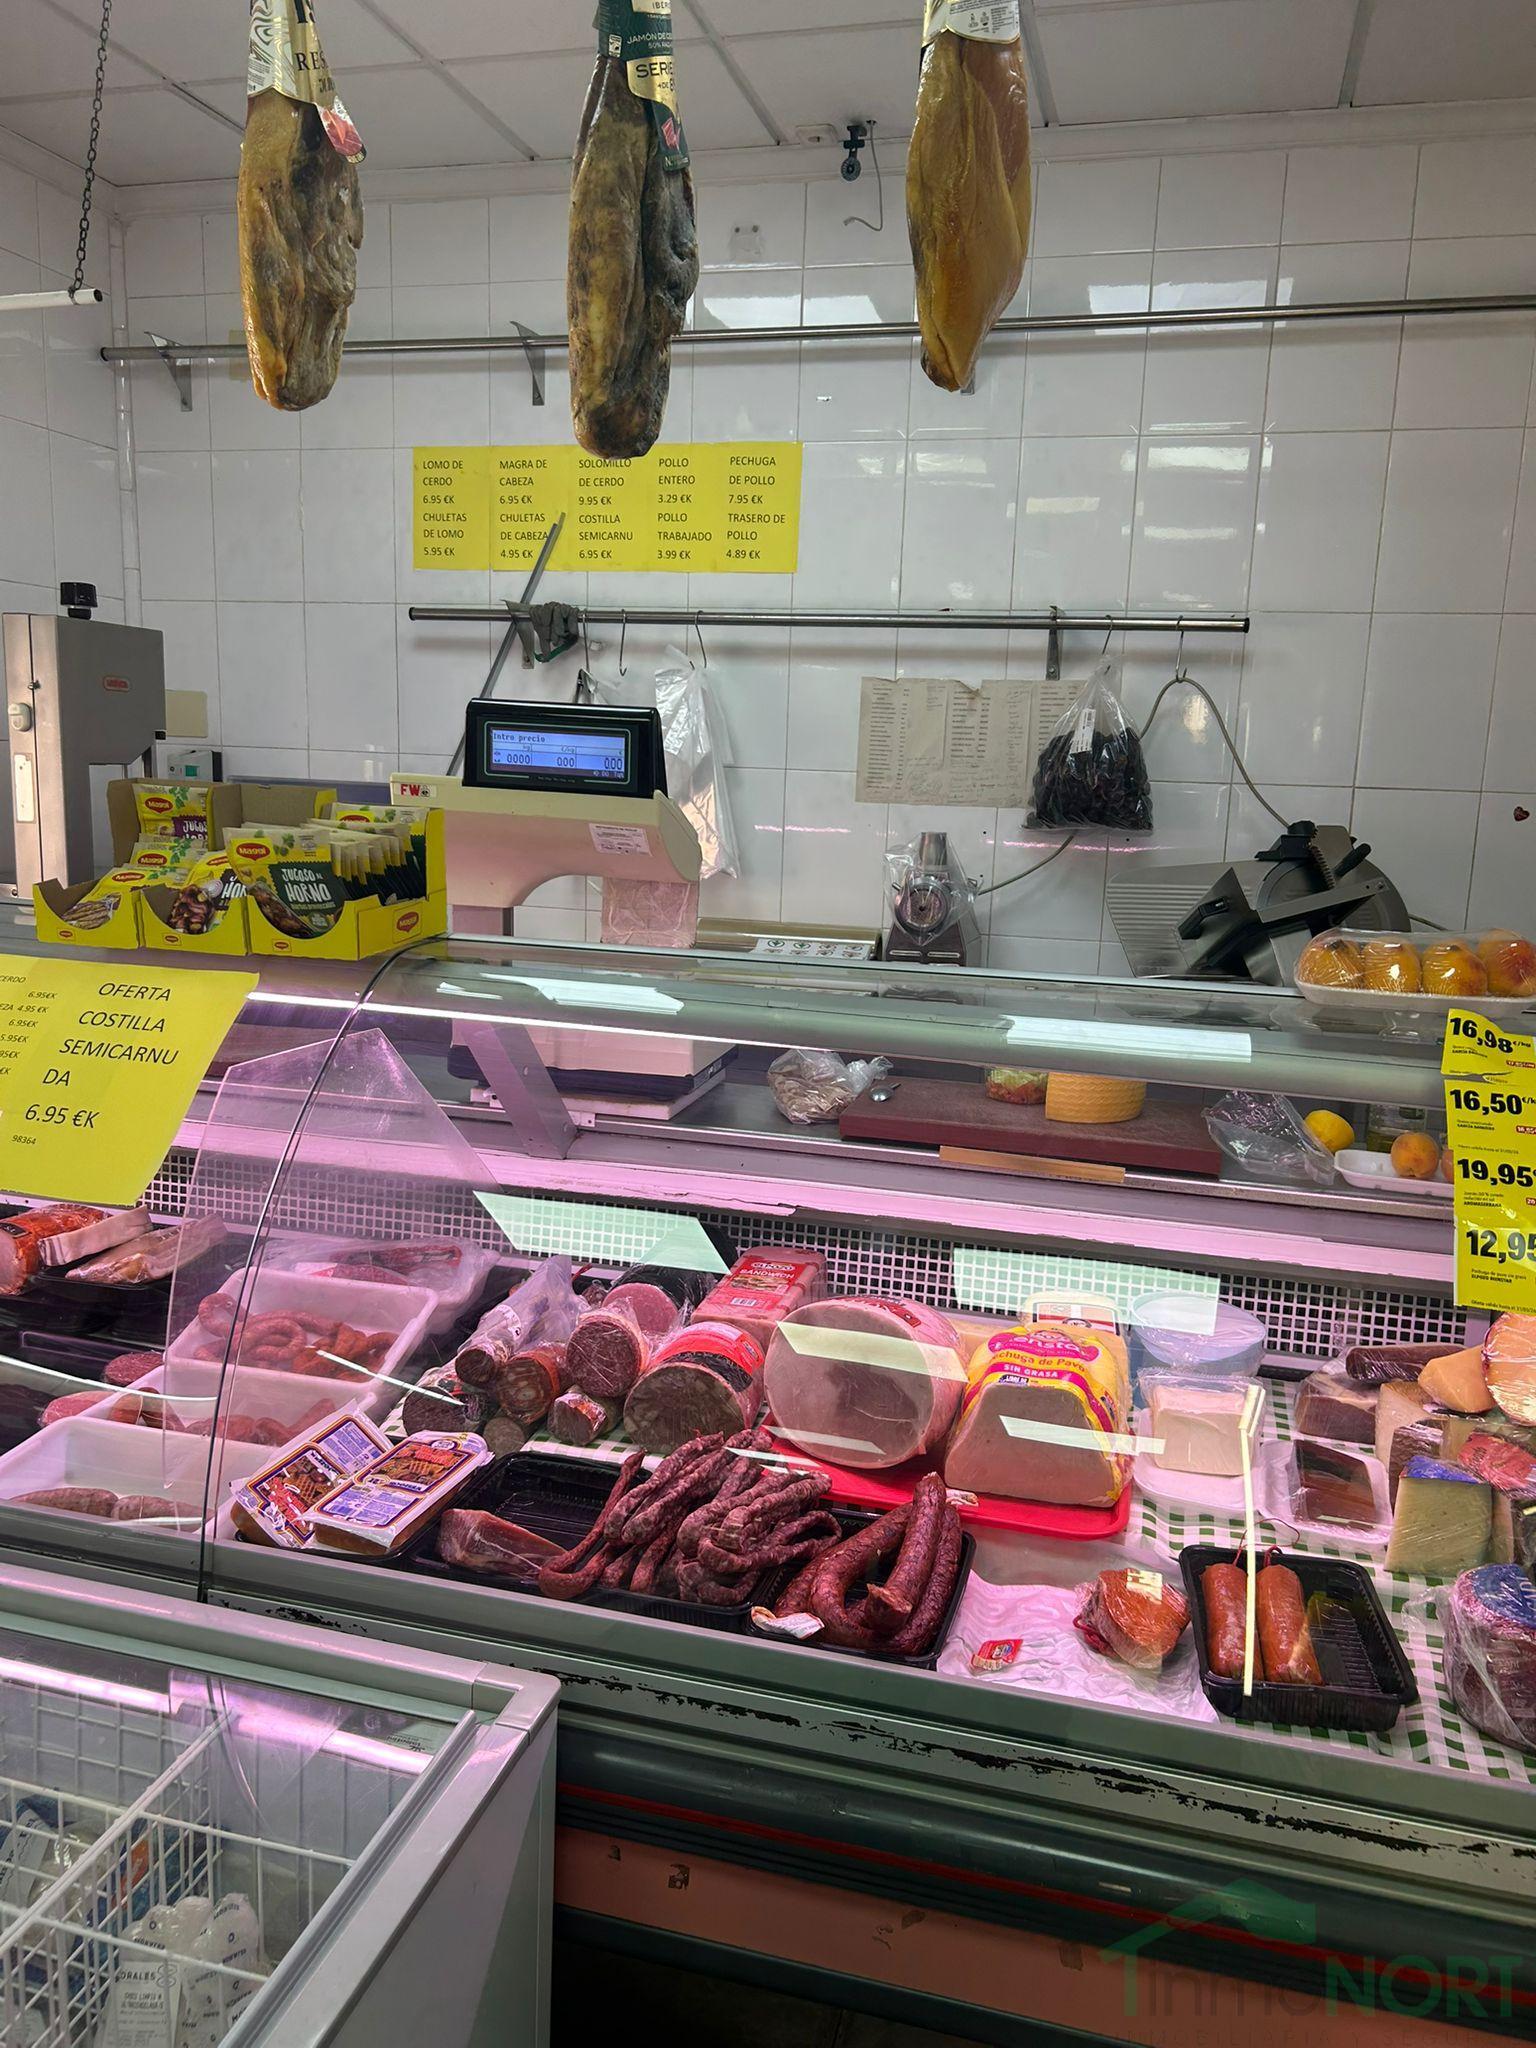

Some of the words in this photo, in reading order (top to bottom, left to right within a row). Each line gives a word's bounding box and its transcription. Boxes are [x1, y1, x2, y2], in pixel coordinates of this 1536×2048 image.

[423, 460, 450, 469] LOMO
[452, 460, 463, 469] DE
[500, 460, 533, 469] MAGRA
[536, 459, 547, 468] DE
[579, 458, 631, 468] SOLOMILLO
[659, 458, 689, 467] POLLO
[730, 456, 776, 466] PECHUGA
[423, 477, 452, 486] CERDO
[500, 477, 534, 486] CABEZA
[579, 478, 591, 487] DE
[593, 477, 624, 487] CERDO
[658, 475, 695, 485] ENTERO
[729, 476, 741, 485] DE
[744, 476, 775, 485] POLLO
[423, 495, 441, 504] 6.95
[443, 495, 454, 504] €K
[500, 496, 519, 504] 6.95
[521, 495, 532, 504] €K
[579, 496, 598, 506] 9.95
[600, 496, 612, 505] €K
[658, 494, 678, 503] 3.29
[680, 495, 692, 504] €K
[729, 495, 749, 504] 7.95
[751, 495, 763, 505] €K
[423, 513, 467, 522] CHULETAS
[500, 513, 545, 522] CHULETAS
[579, 515, 620, 524] COSTILLA
[658, 513, 687, 522] POLLO
[728, 513, 771, 523] TRASERO
[773, 514, 785, 524] DE
[424, 529, 435, 538] DE
[437, 530, 464, 539] LOMO
[501, 532, 512, 541] DE
[514, 531, 548, 541] CABEZA
[579, 532, 633, 541] SEMICARNU
[658, 532, 712, 541] TRABAJADO
[727, 531, 757, 540] POLLO
[424, 547, 442, 556] 5.95
[444, 547, 455, 556] €K
[501, 550, 520, 559] 4.95
[522, 550, 533, 559] €K
[579, 550, 599, 559] 6.95
[600, 550, 612, 559] €K
[658, 550, 677, 559] 3.99
[679, 550, 691, 559] €K
[726, 549, 747, 559] 4.89
[749, 550, 760, 559] €K
[493, 733, 514, 741] Intro
[518, 735, 546, 743] precio
[281, 868, 315, 882] JUGOSO
[285, 883, 331, 903] HORNO
[98, 982, 171, 1002] OFERTA
[17, 1005, 36, 1013] 4.95
[37, 1006, 49, 1014] €K
[78, 1010, 165, 1033] COSTILLA
[1450, 1017, 1513, 1053] 16,98
[59, 1038, 179, 1065] SEMICARNU
[42, 1068, 71, 1087] DA
[1450, 1089, 1523, 1116] 16,50
[25, 1103, 69, 1124] 6.95
[72, 1109, 99, 1129] €K
[12, 1134, 37, 1146] 98364
[1457, 1158, 1534, 1188] 19,95
[1466, 1229, 1536, 1264] 12,95
[739, 1269, 795, 1279] SANDWICH
[1038, 1358, 1053, 1366] de
[1056, 1358, 1085, 1372] Pavo
[1004, 1363, 1021, 1373] SIN
[1024, 1369, 1058, 1378] GRASA
[115, 1970, 157, 1984] ORALES
